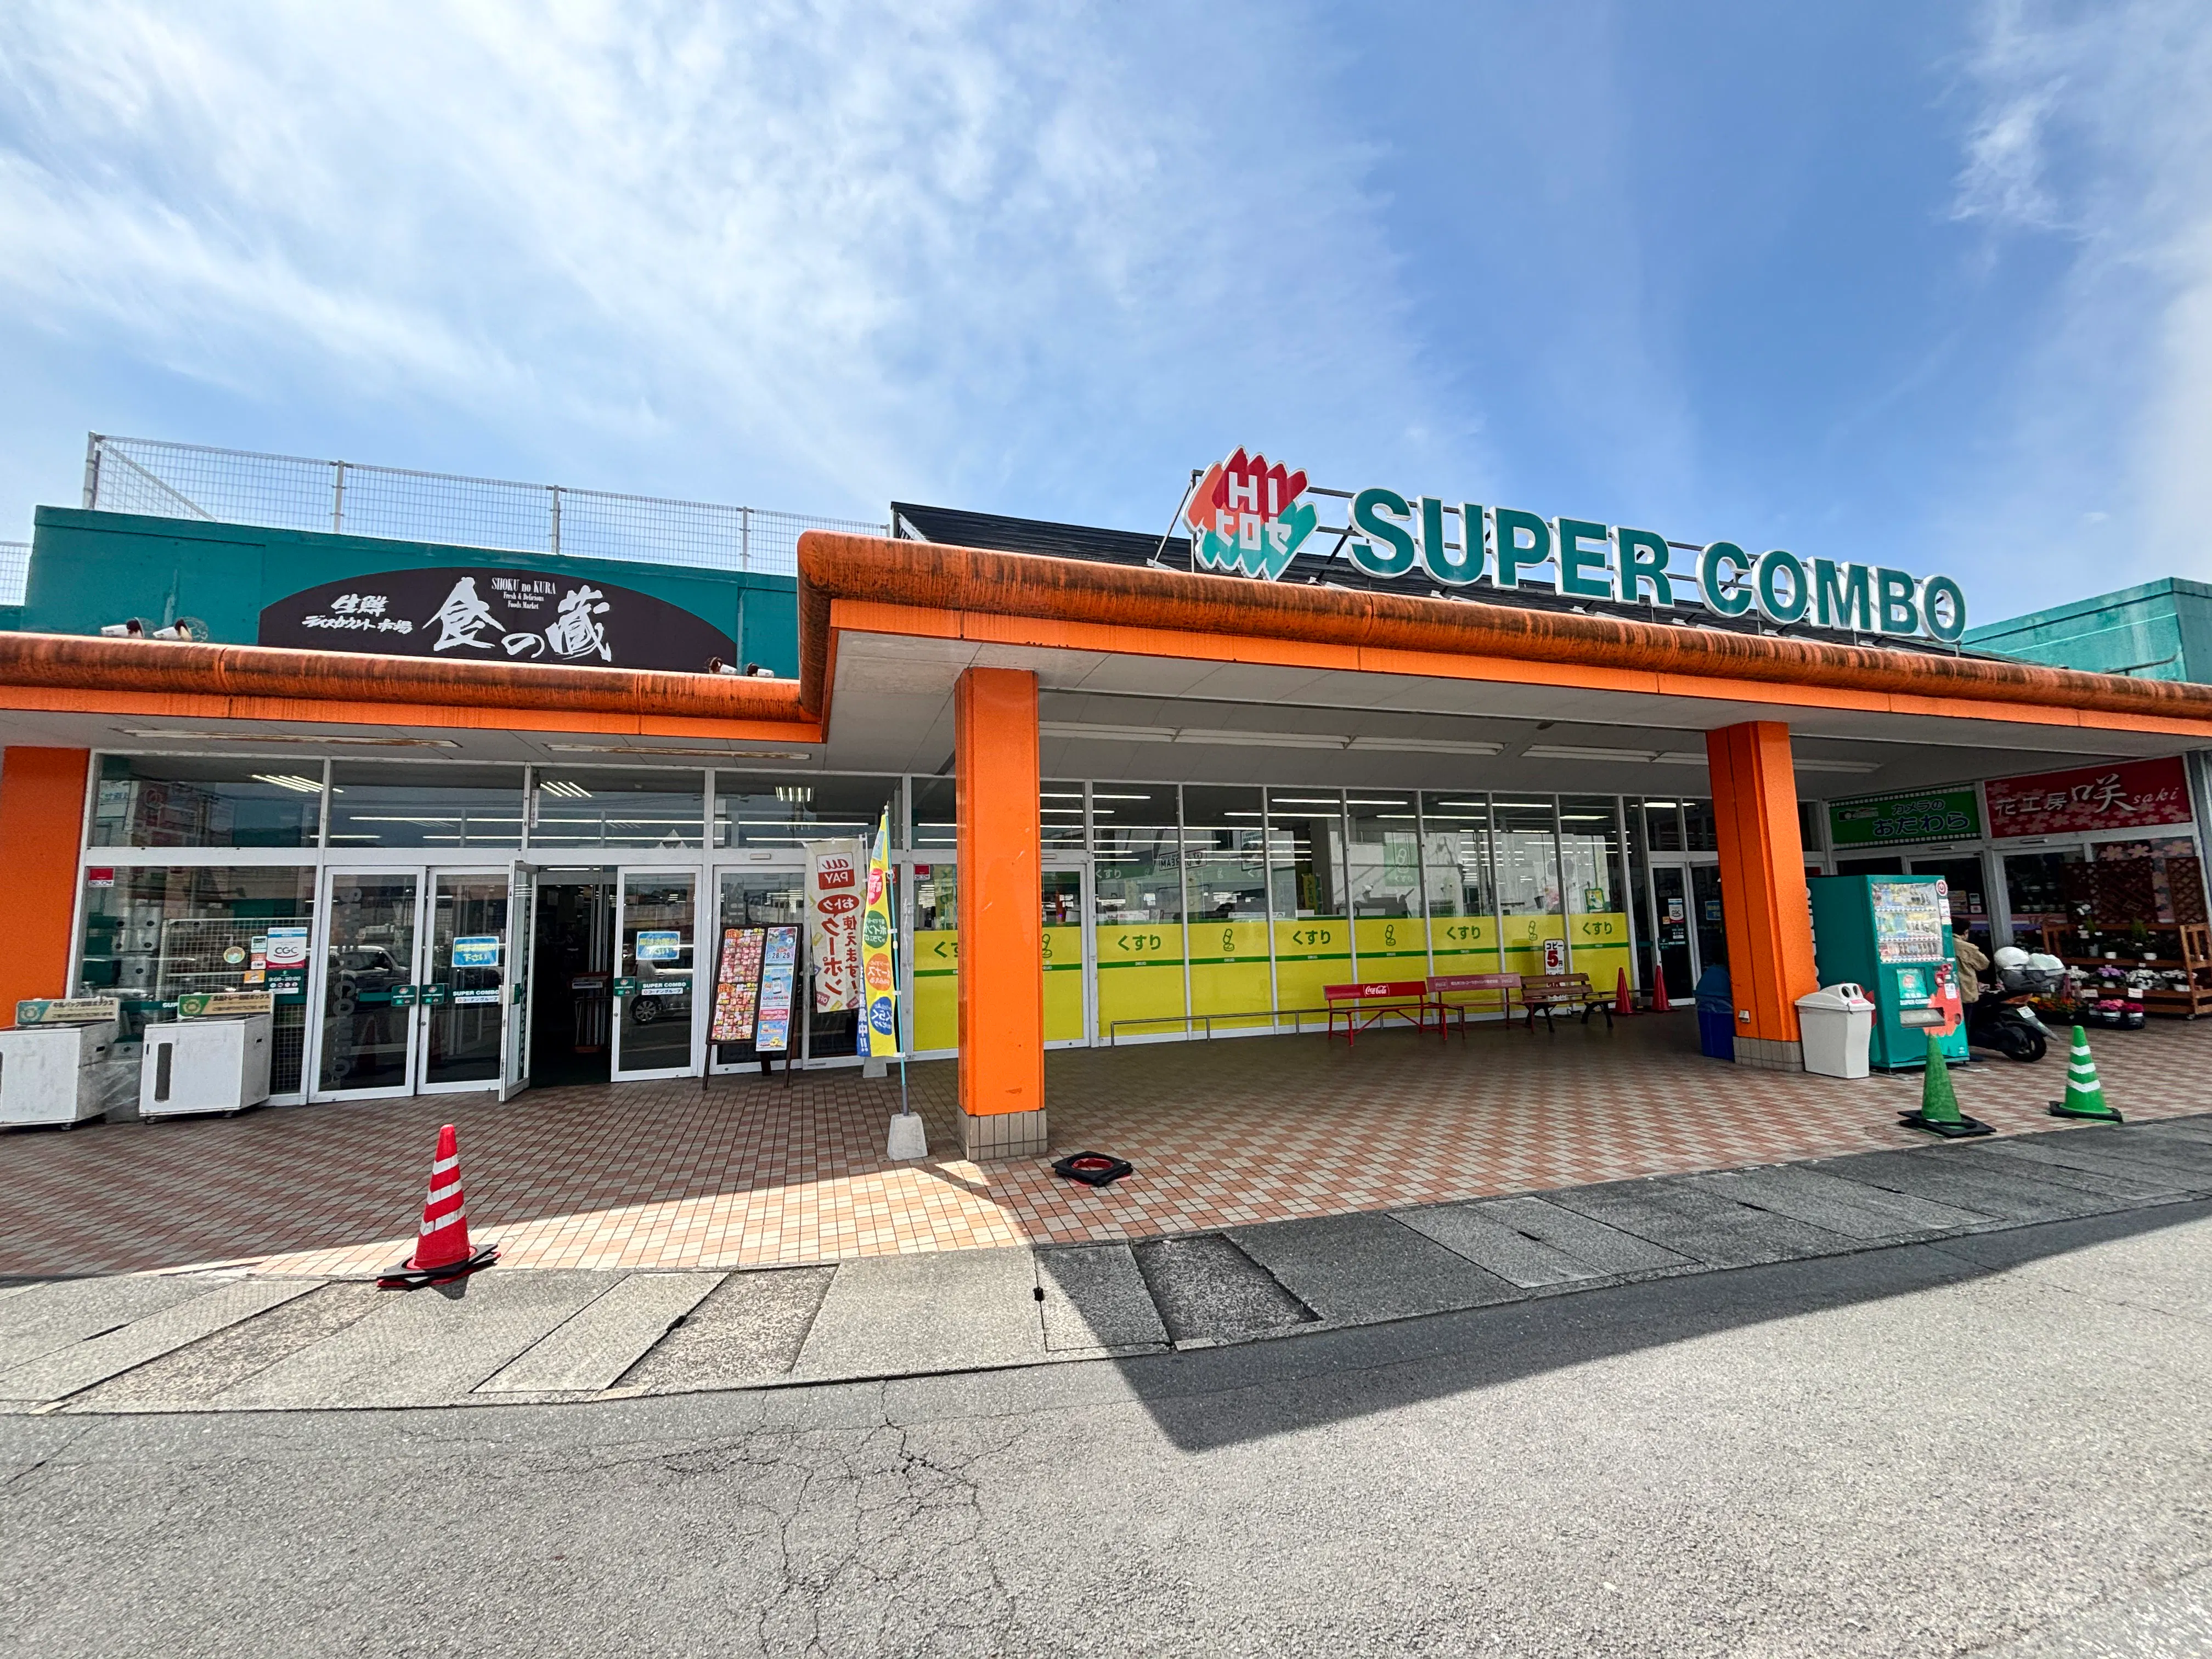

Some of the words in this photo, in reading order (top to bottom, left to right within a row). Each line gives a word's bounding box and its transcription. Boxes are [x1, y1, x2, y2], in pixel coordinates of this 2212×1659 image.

[1228, 471, 1278, 515] HI
[1216, 509, 1292, 556] ヒロセ
[1347, 487, 1675, 609] SUPER
[1696, 541, 1967, 643] COMBO
[492, 577, 520, 592] SHOKU
[521, 583, 531, 592] no
[533, 580, 556, 595] KURA
[503, 591, 517, 600] Fresh
[331, 594, 388, 617] 生鮮
[507, 600, 521, 608] Foods
[522, 602, 539, 610] Market
[422, 577, 612, 662] 食の蔵
[2132, 787, 2180, 804] saki
[1892, 799, 1945, 815] カメラの
[1872, 812, 1971, 837] おたわら
[1447, 926, 1481, 940] くすり
[1583, 922, 1612, 935] くすり
[1118, 934, 1161, 951] くすり
[1293, 930, 1330, 945] くすり
[1546, 941, 1564, 950] コピー
